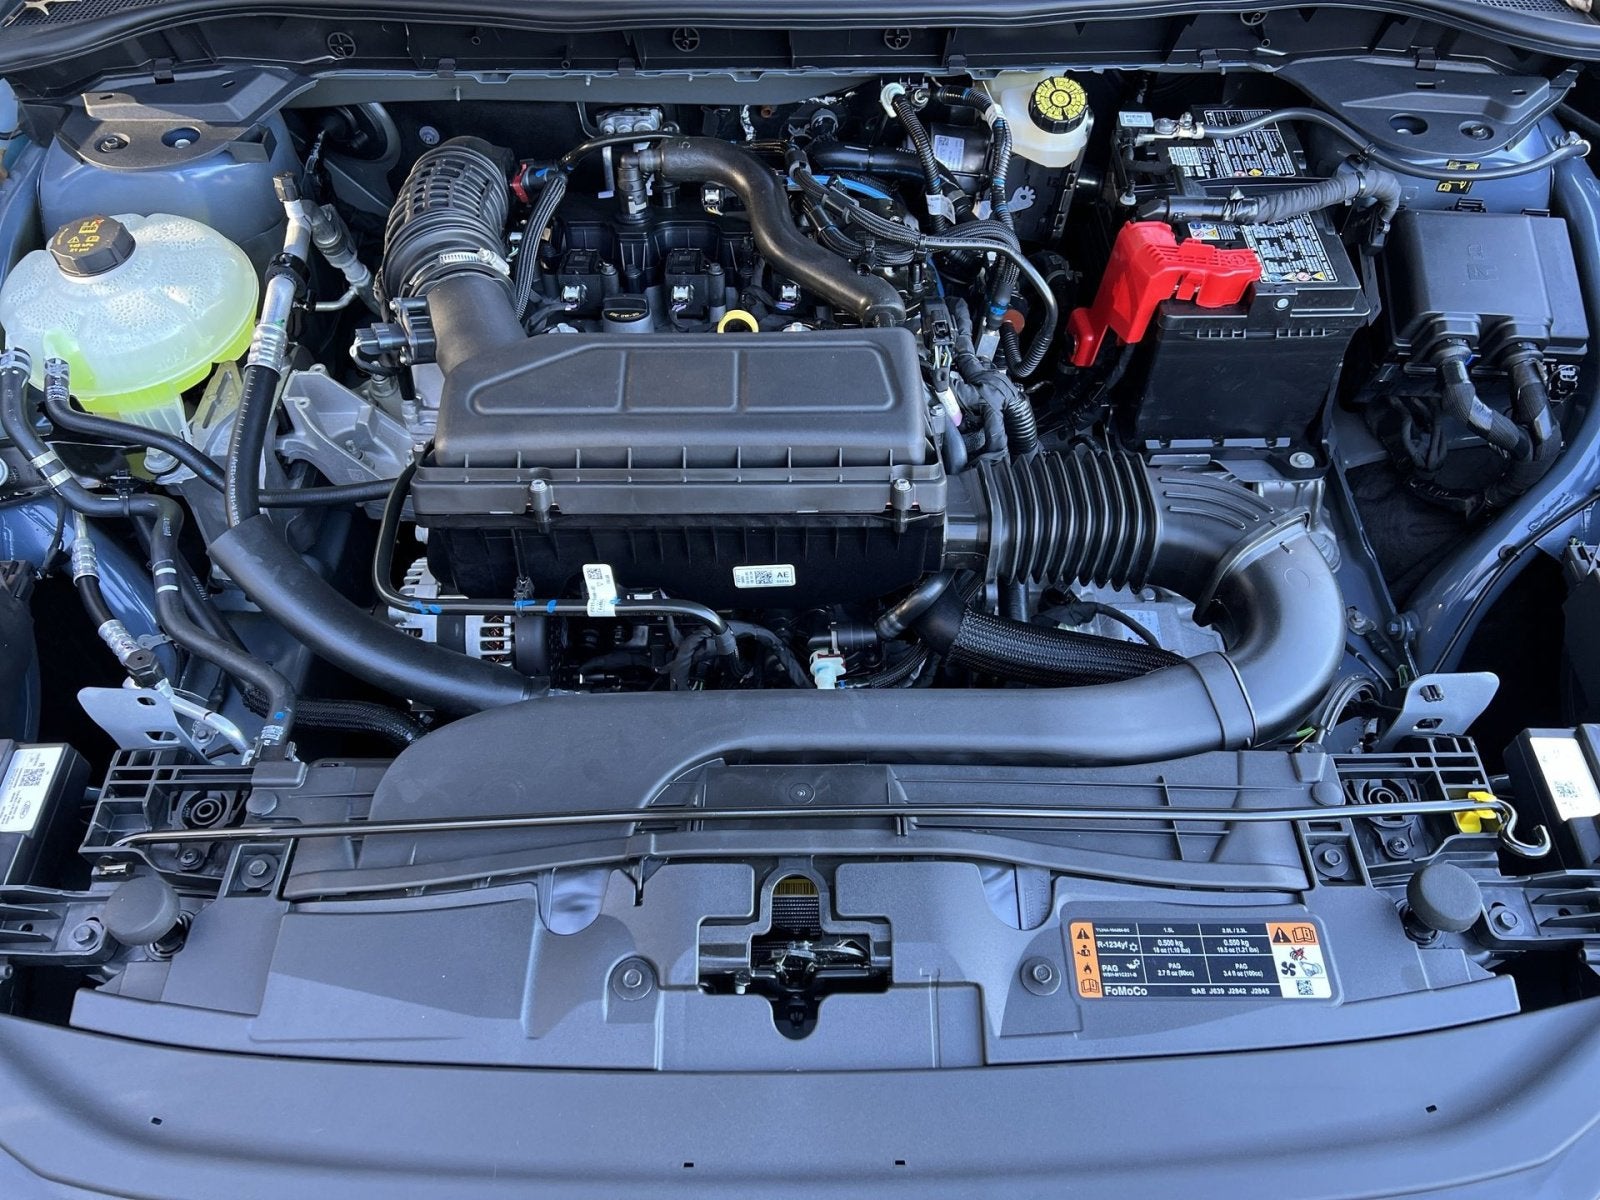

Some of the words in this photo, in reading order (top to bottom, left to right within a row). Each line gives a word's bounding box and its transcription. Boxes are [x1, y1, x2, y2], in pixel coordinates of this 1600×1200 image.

[1097, 940, 1128, 950] R-1234yf
[1157, 939, 1174, 947] 0.500
[1174, 939, 1184, 947] kg
[1241, 939, 1250, 947] kg
[1101, 964, 1119, 972] PAG
[1104, 986, 1148, 996] FoMoCo
[1191, 987, 1207, 995] SAE
[1209, 987, 1225, 995] J639
